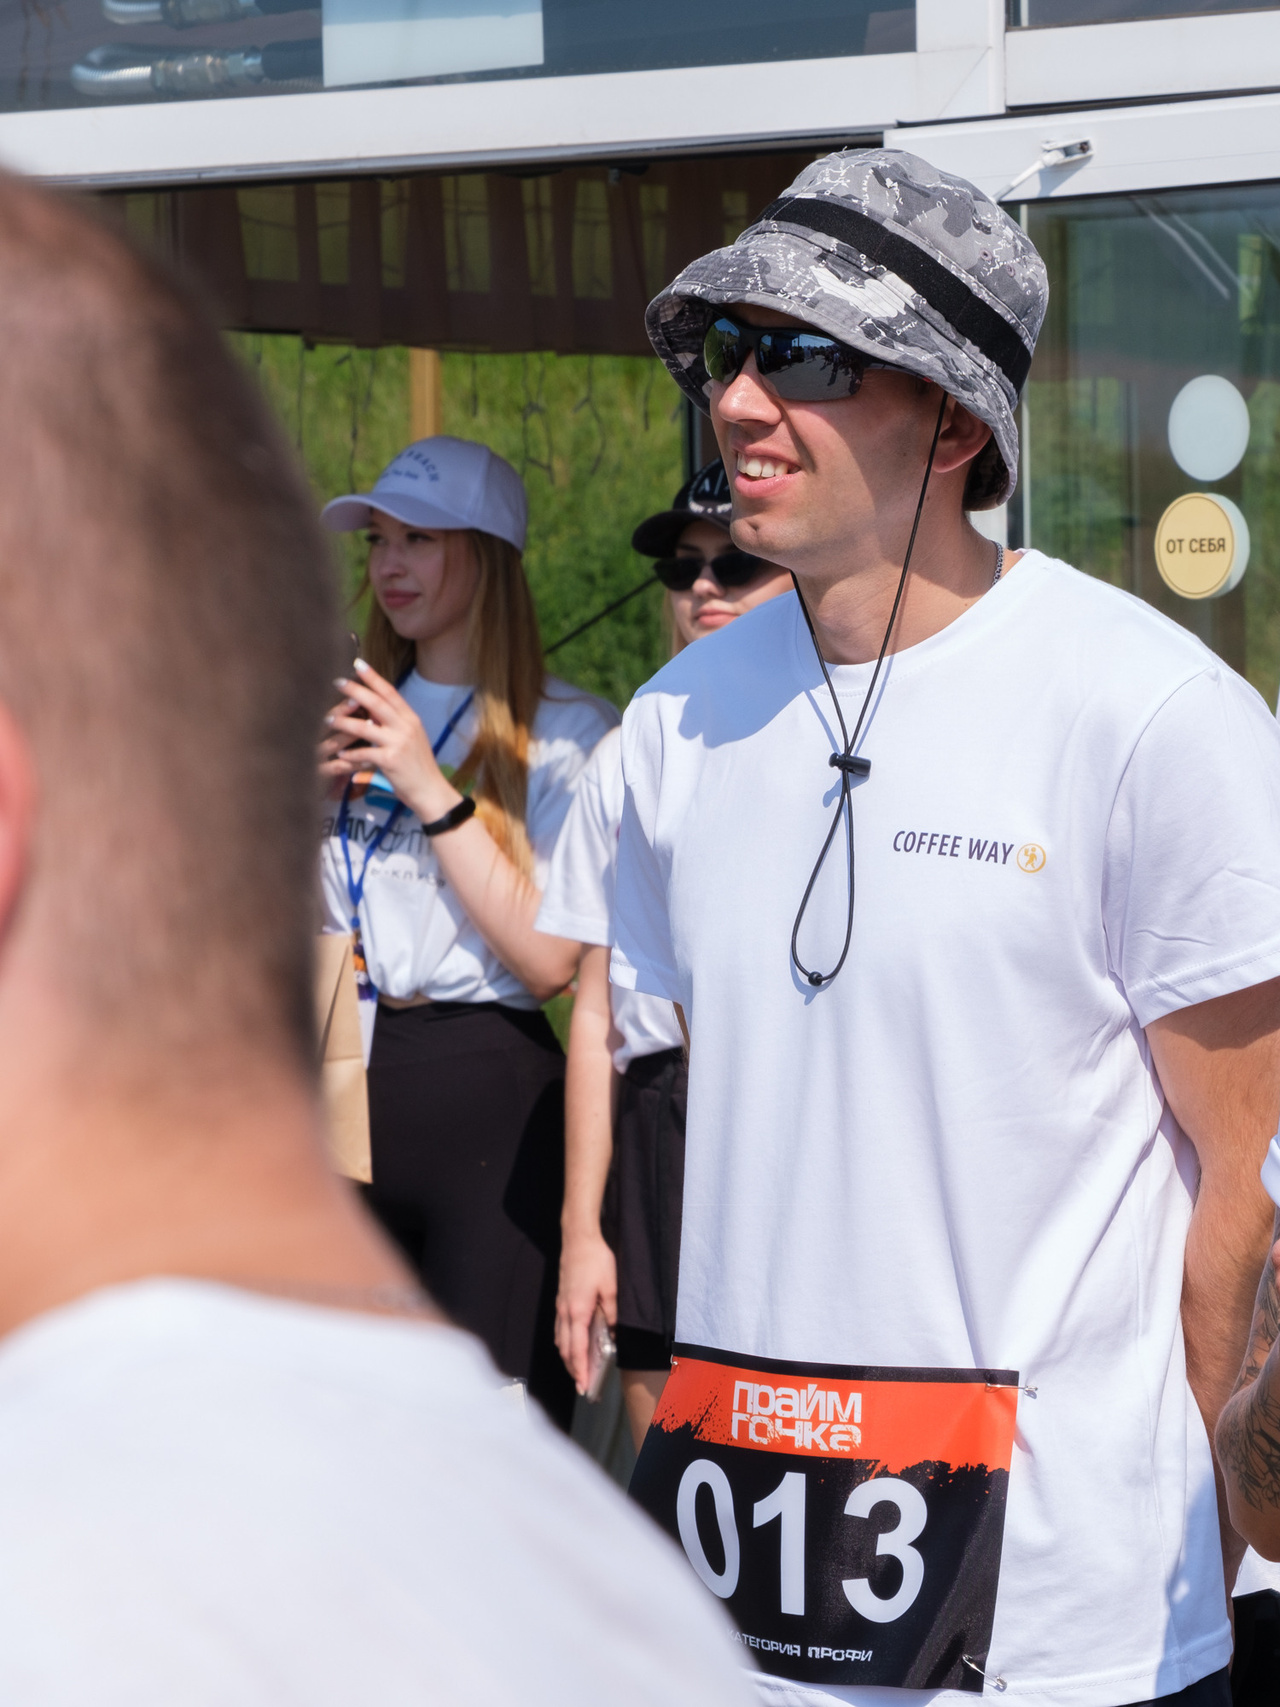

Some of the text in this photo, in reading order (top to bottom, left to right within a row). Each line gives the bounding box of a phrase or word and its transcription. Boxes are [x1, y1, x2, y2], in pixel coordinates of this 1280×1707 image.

[1166, 537, 1226, 554] ОТ СЕБЯ
[893, 830, 1015, 865] COFFEE WAY
[676, 1458, 928, 1623] 013
[807, 1646, 873, 1662] ПРОФИ
